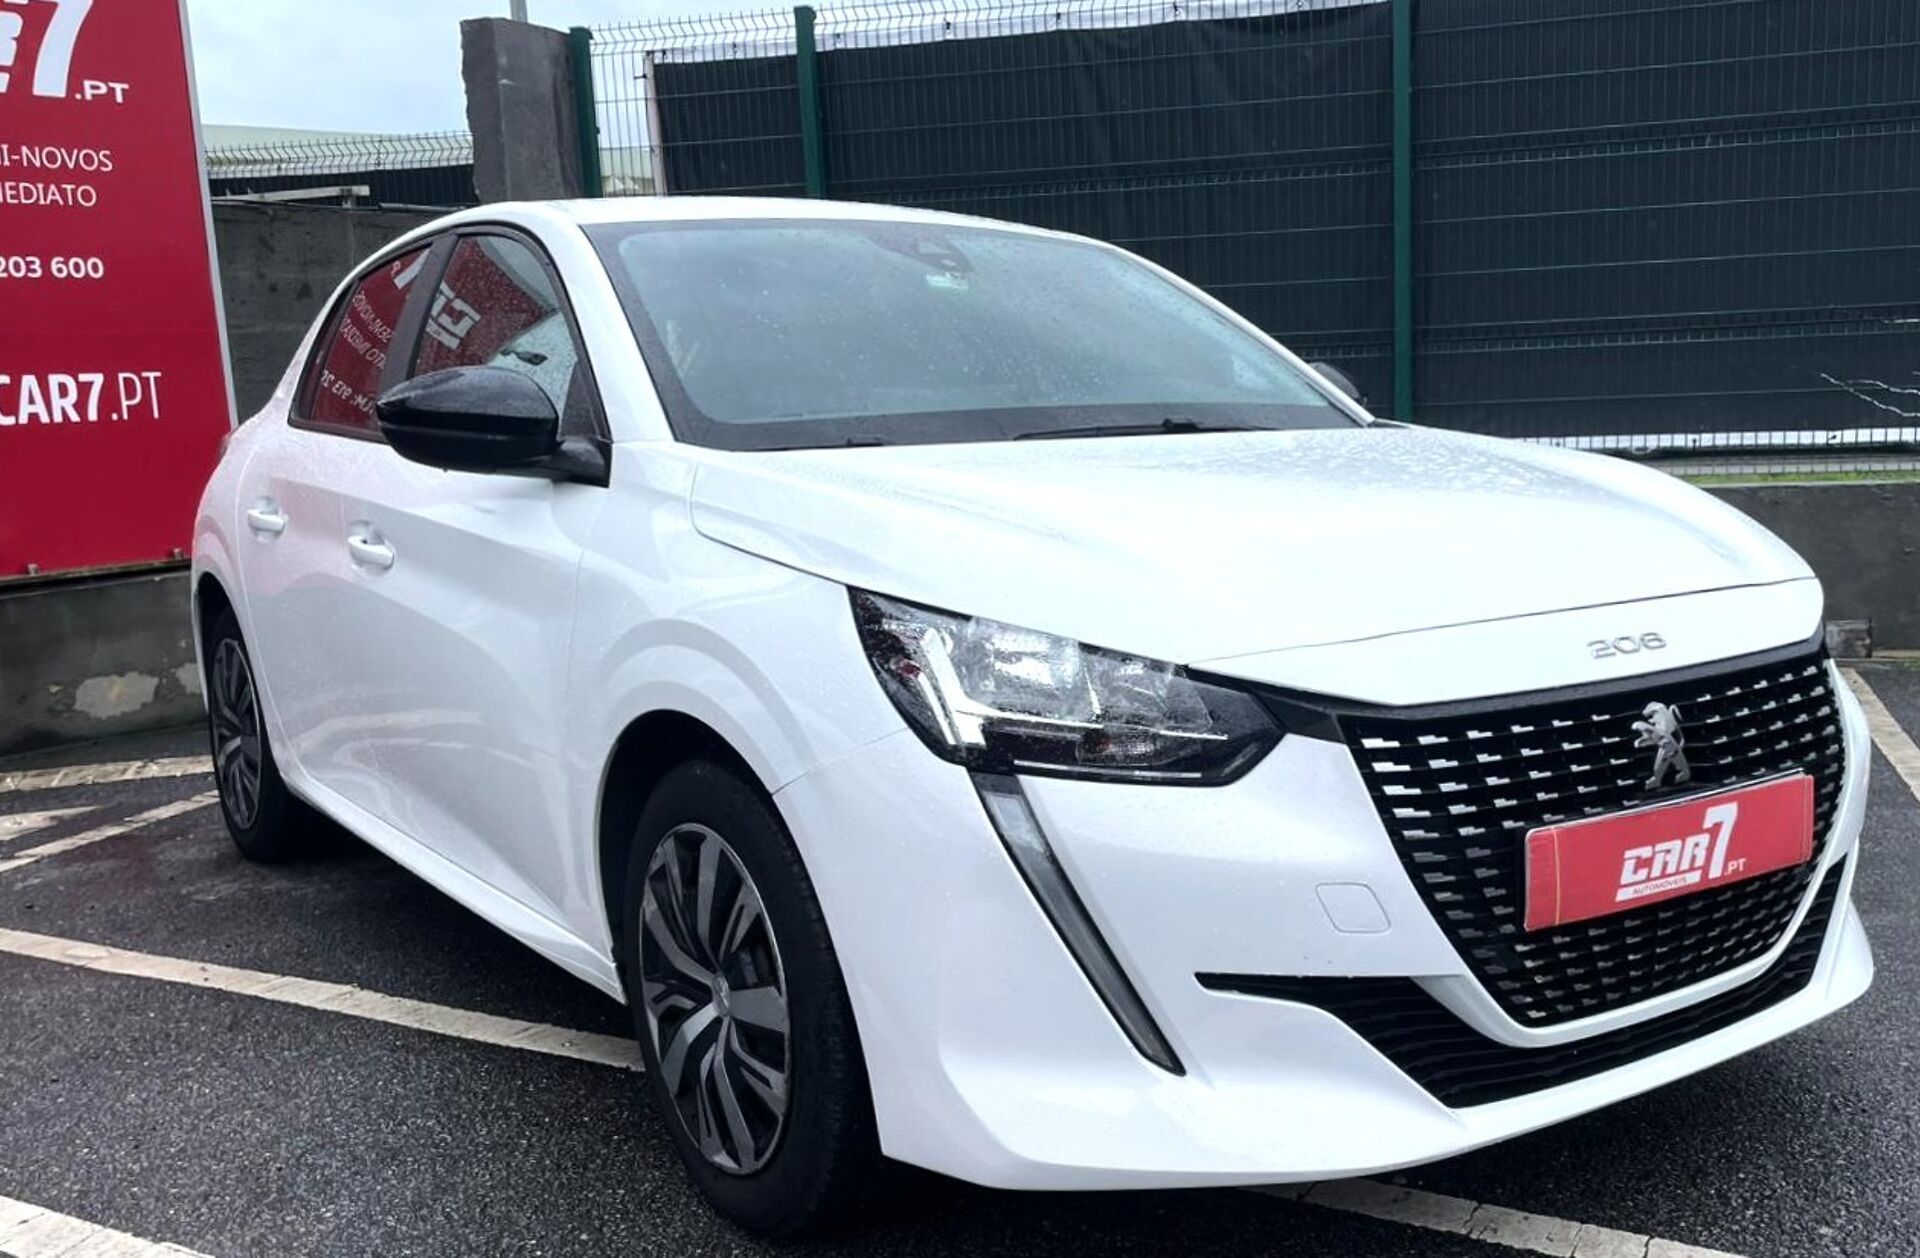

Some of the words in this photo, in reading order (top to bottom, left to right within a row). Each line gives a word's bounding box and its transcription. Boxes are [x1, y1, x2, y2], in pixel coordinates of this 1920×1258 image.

[0, 143, 113, 172] I-NOVOS
[0, 181, 97, 207] EDIATO
[50, 256, 104, 279] 600
